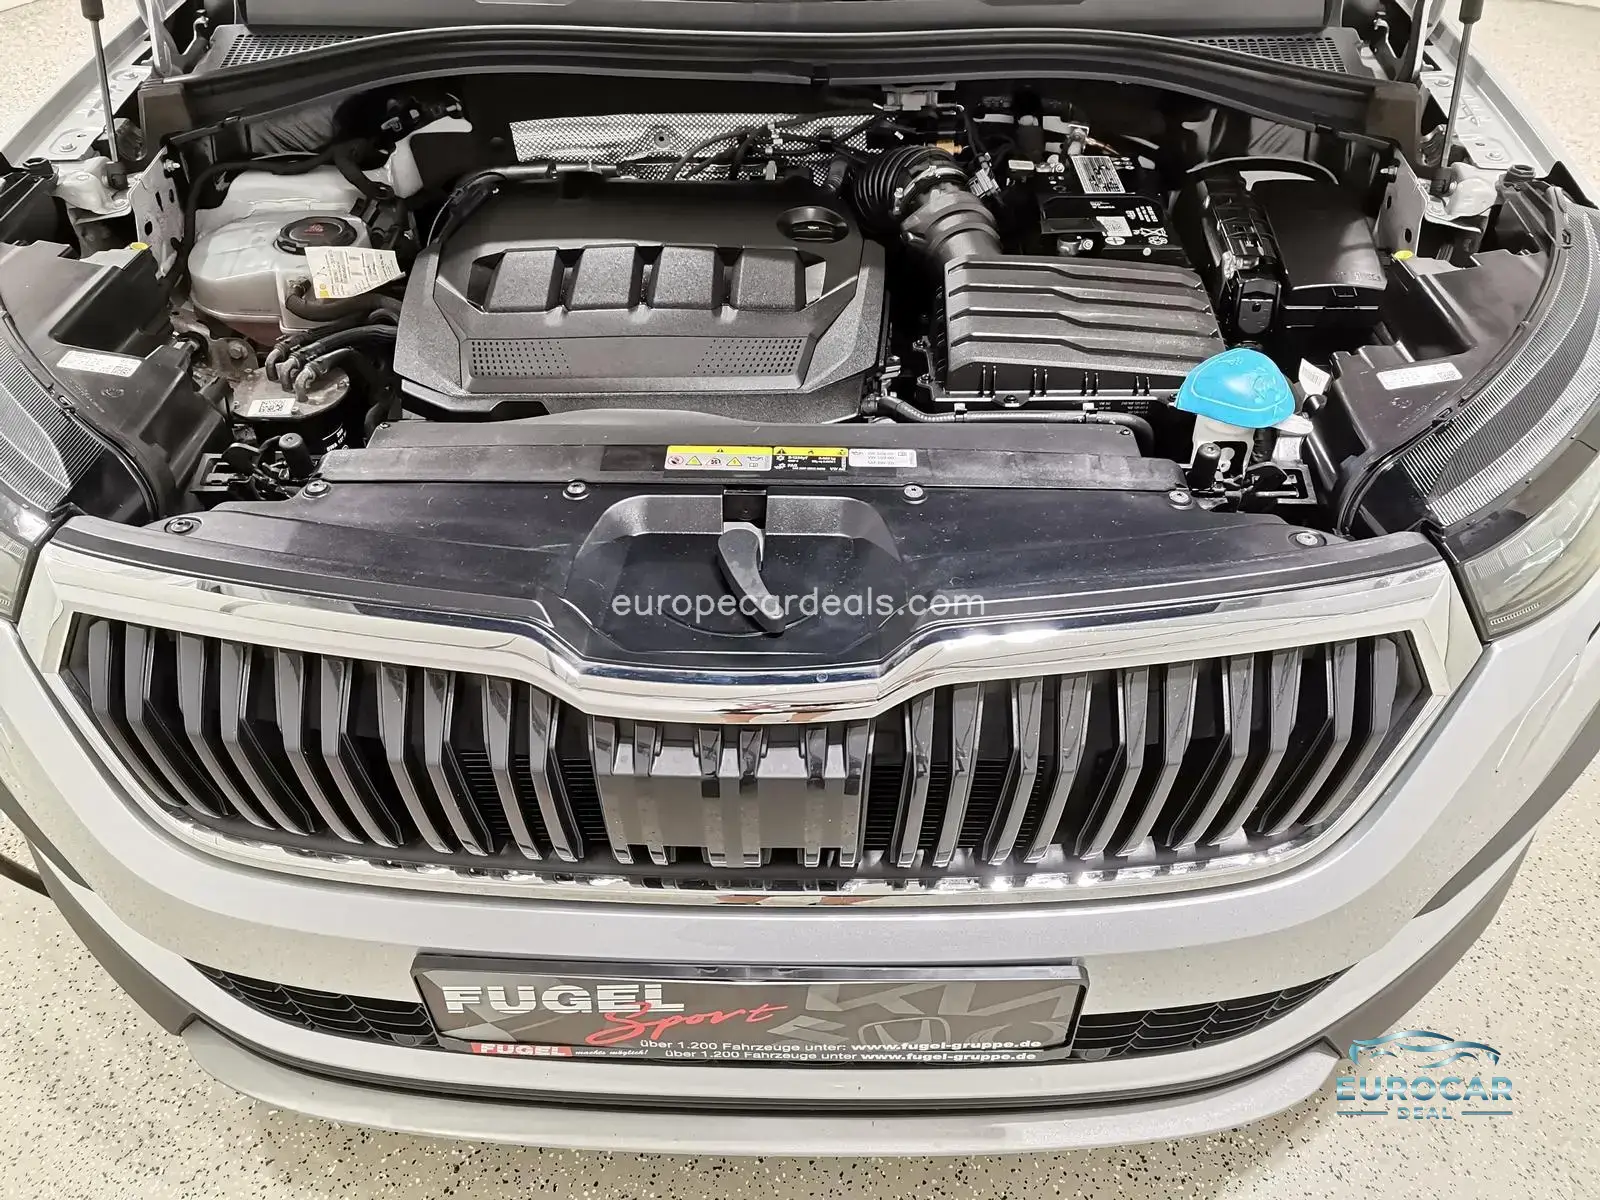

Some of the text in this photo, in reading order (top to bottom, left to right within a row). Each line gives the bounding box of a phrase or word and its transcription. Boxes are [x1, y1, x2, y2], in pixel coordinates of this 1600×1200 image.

[442, 985, 685, 1014] FUGEL
[585, 1001, 788, 1045] Sport
[480, 1043, 566, 1056] FUGEL
[640, 1039, 1042, 1052] über 1.200 Fahrzeuge unter: www.fugel-gruppe.de
[665, 1050, 697, 1058] über
[744, 1051, 817, 1060] Fahrzeuge
[821, 1052, 857, 1060] unter
[860, 1052, 1037, 1061] www.fugel-gruppe.de
